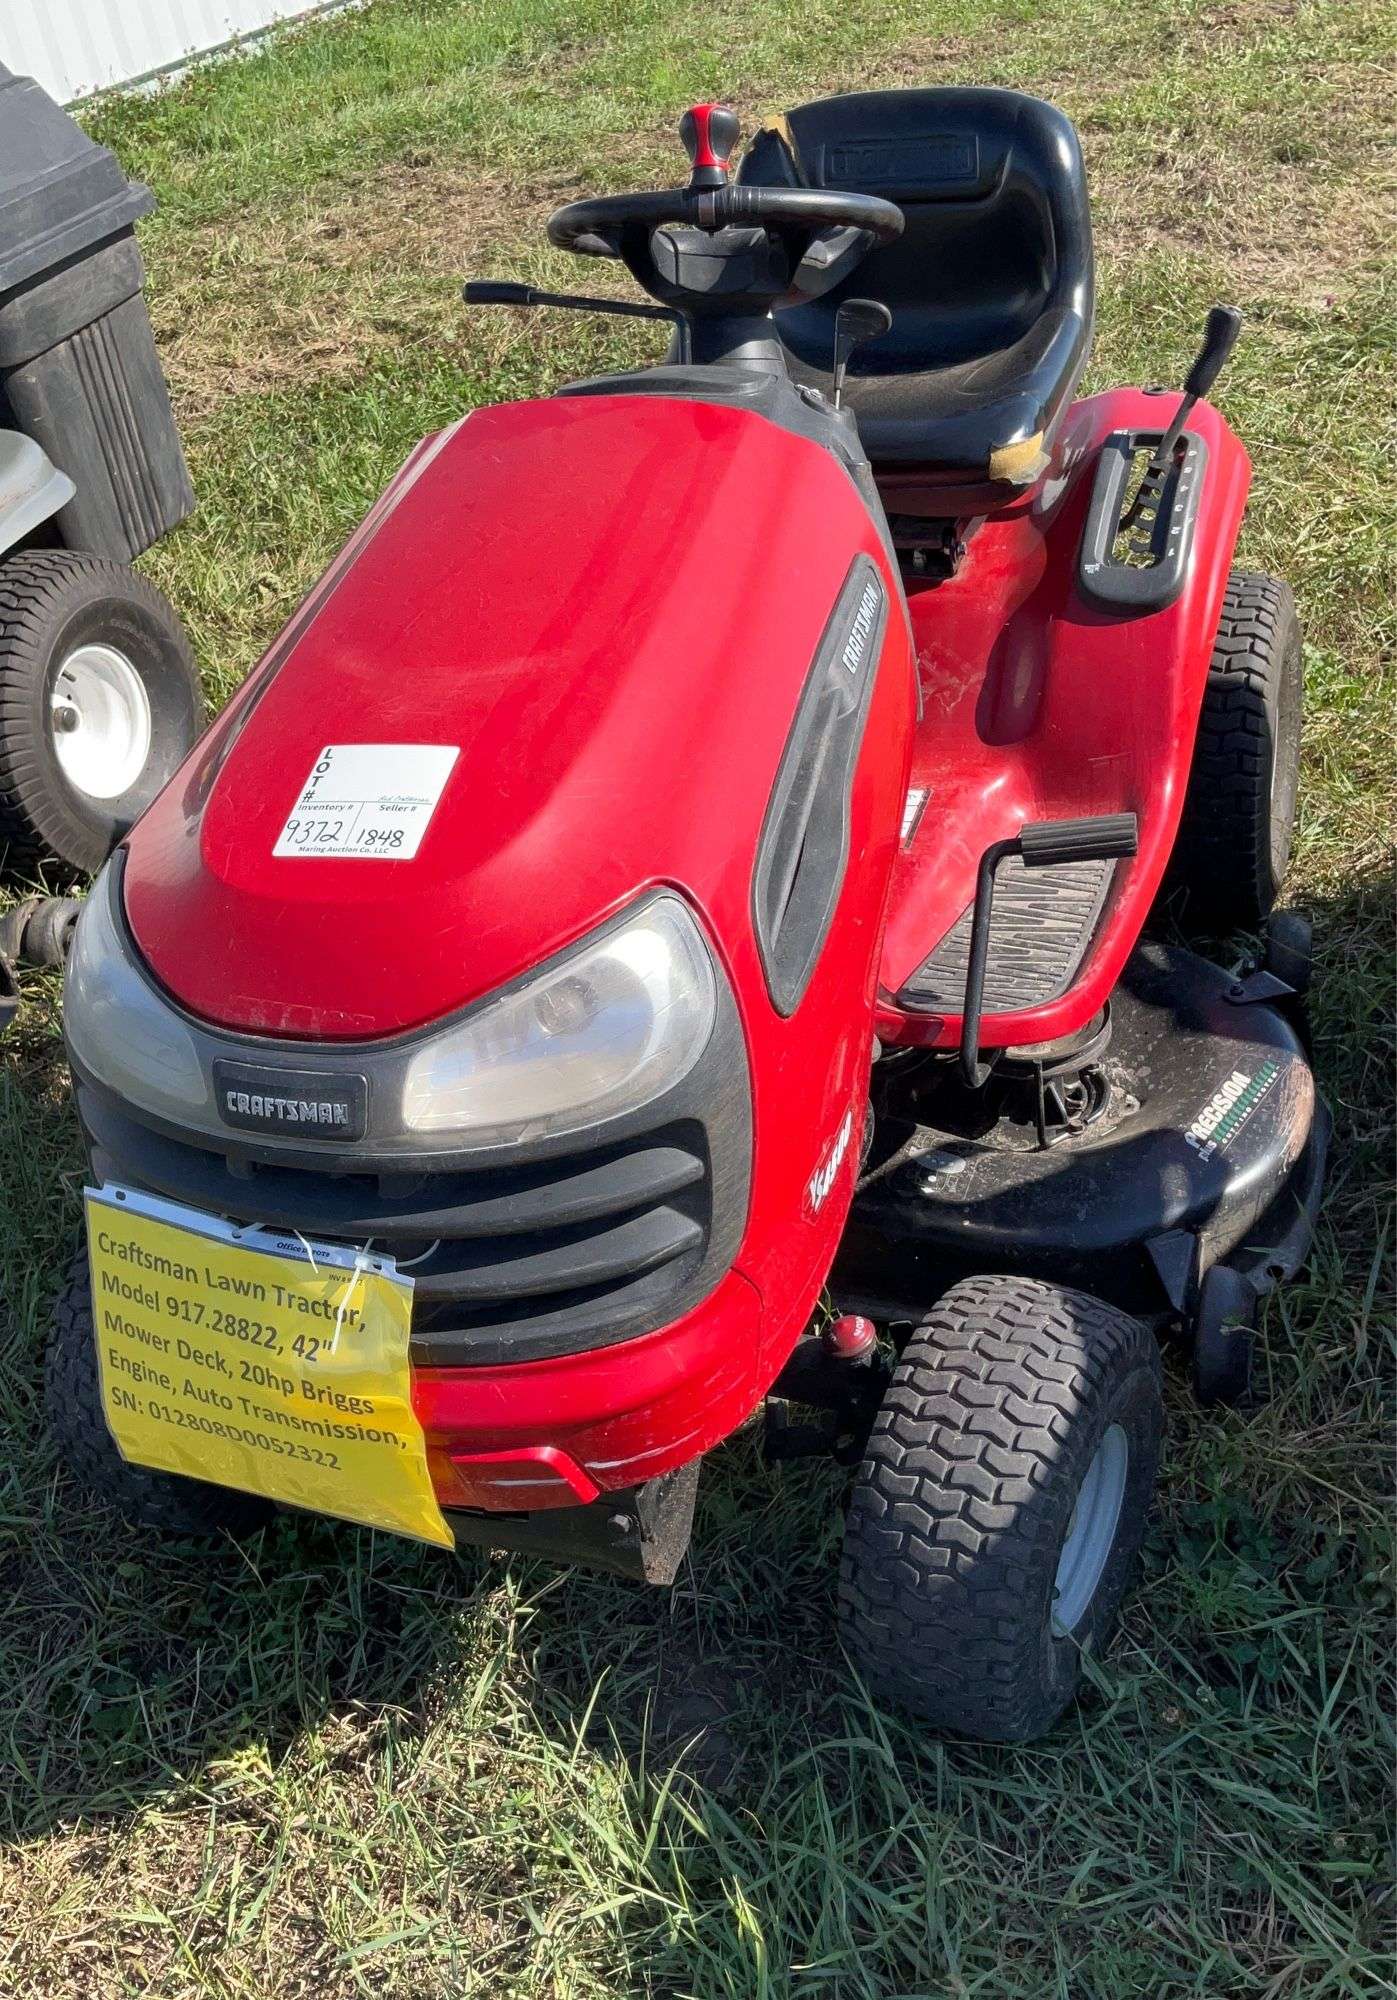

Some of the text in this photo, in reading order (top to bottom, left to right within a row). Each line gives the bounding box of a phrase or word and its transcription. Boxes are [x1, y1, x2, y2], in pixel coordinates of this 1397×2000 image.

[842, 583, 878, 674] CRAFTSMAN
[298, 804, 345, 812] Inventory
[379, 804, 408, 812] Seller
[287, 820, 343, 844] 9372
[298, 846, 327, 854] Maring
[356, 829, 404, 848] 1848
[227, 1091, 349, 1124] CRAFTSMAN
[1184, 1071, 1251, 1149] PRECISION
[1222, 1107, 1252, 1143] CUTTING
[1198, 1140, 1217, 1162] plus
[98, 1232, 366, 1332] Craftsman Lawn Tractor,
[101, 1270, 333, 1362] Model 917.28822, 42"
[104, 1310, 375, 1415] Mower Deck, 20hp Briggs
[109, 1348, 407, 1450] Engine, Auto Transmission,
[111, 1386, 342, 1471] SN: 012808D0052322
